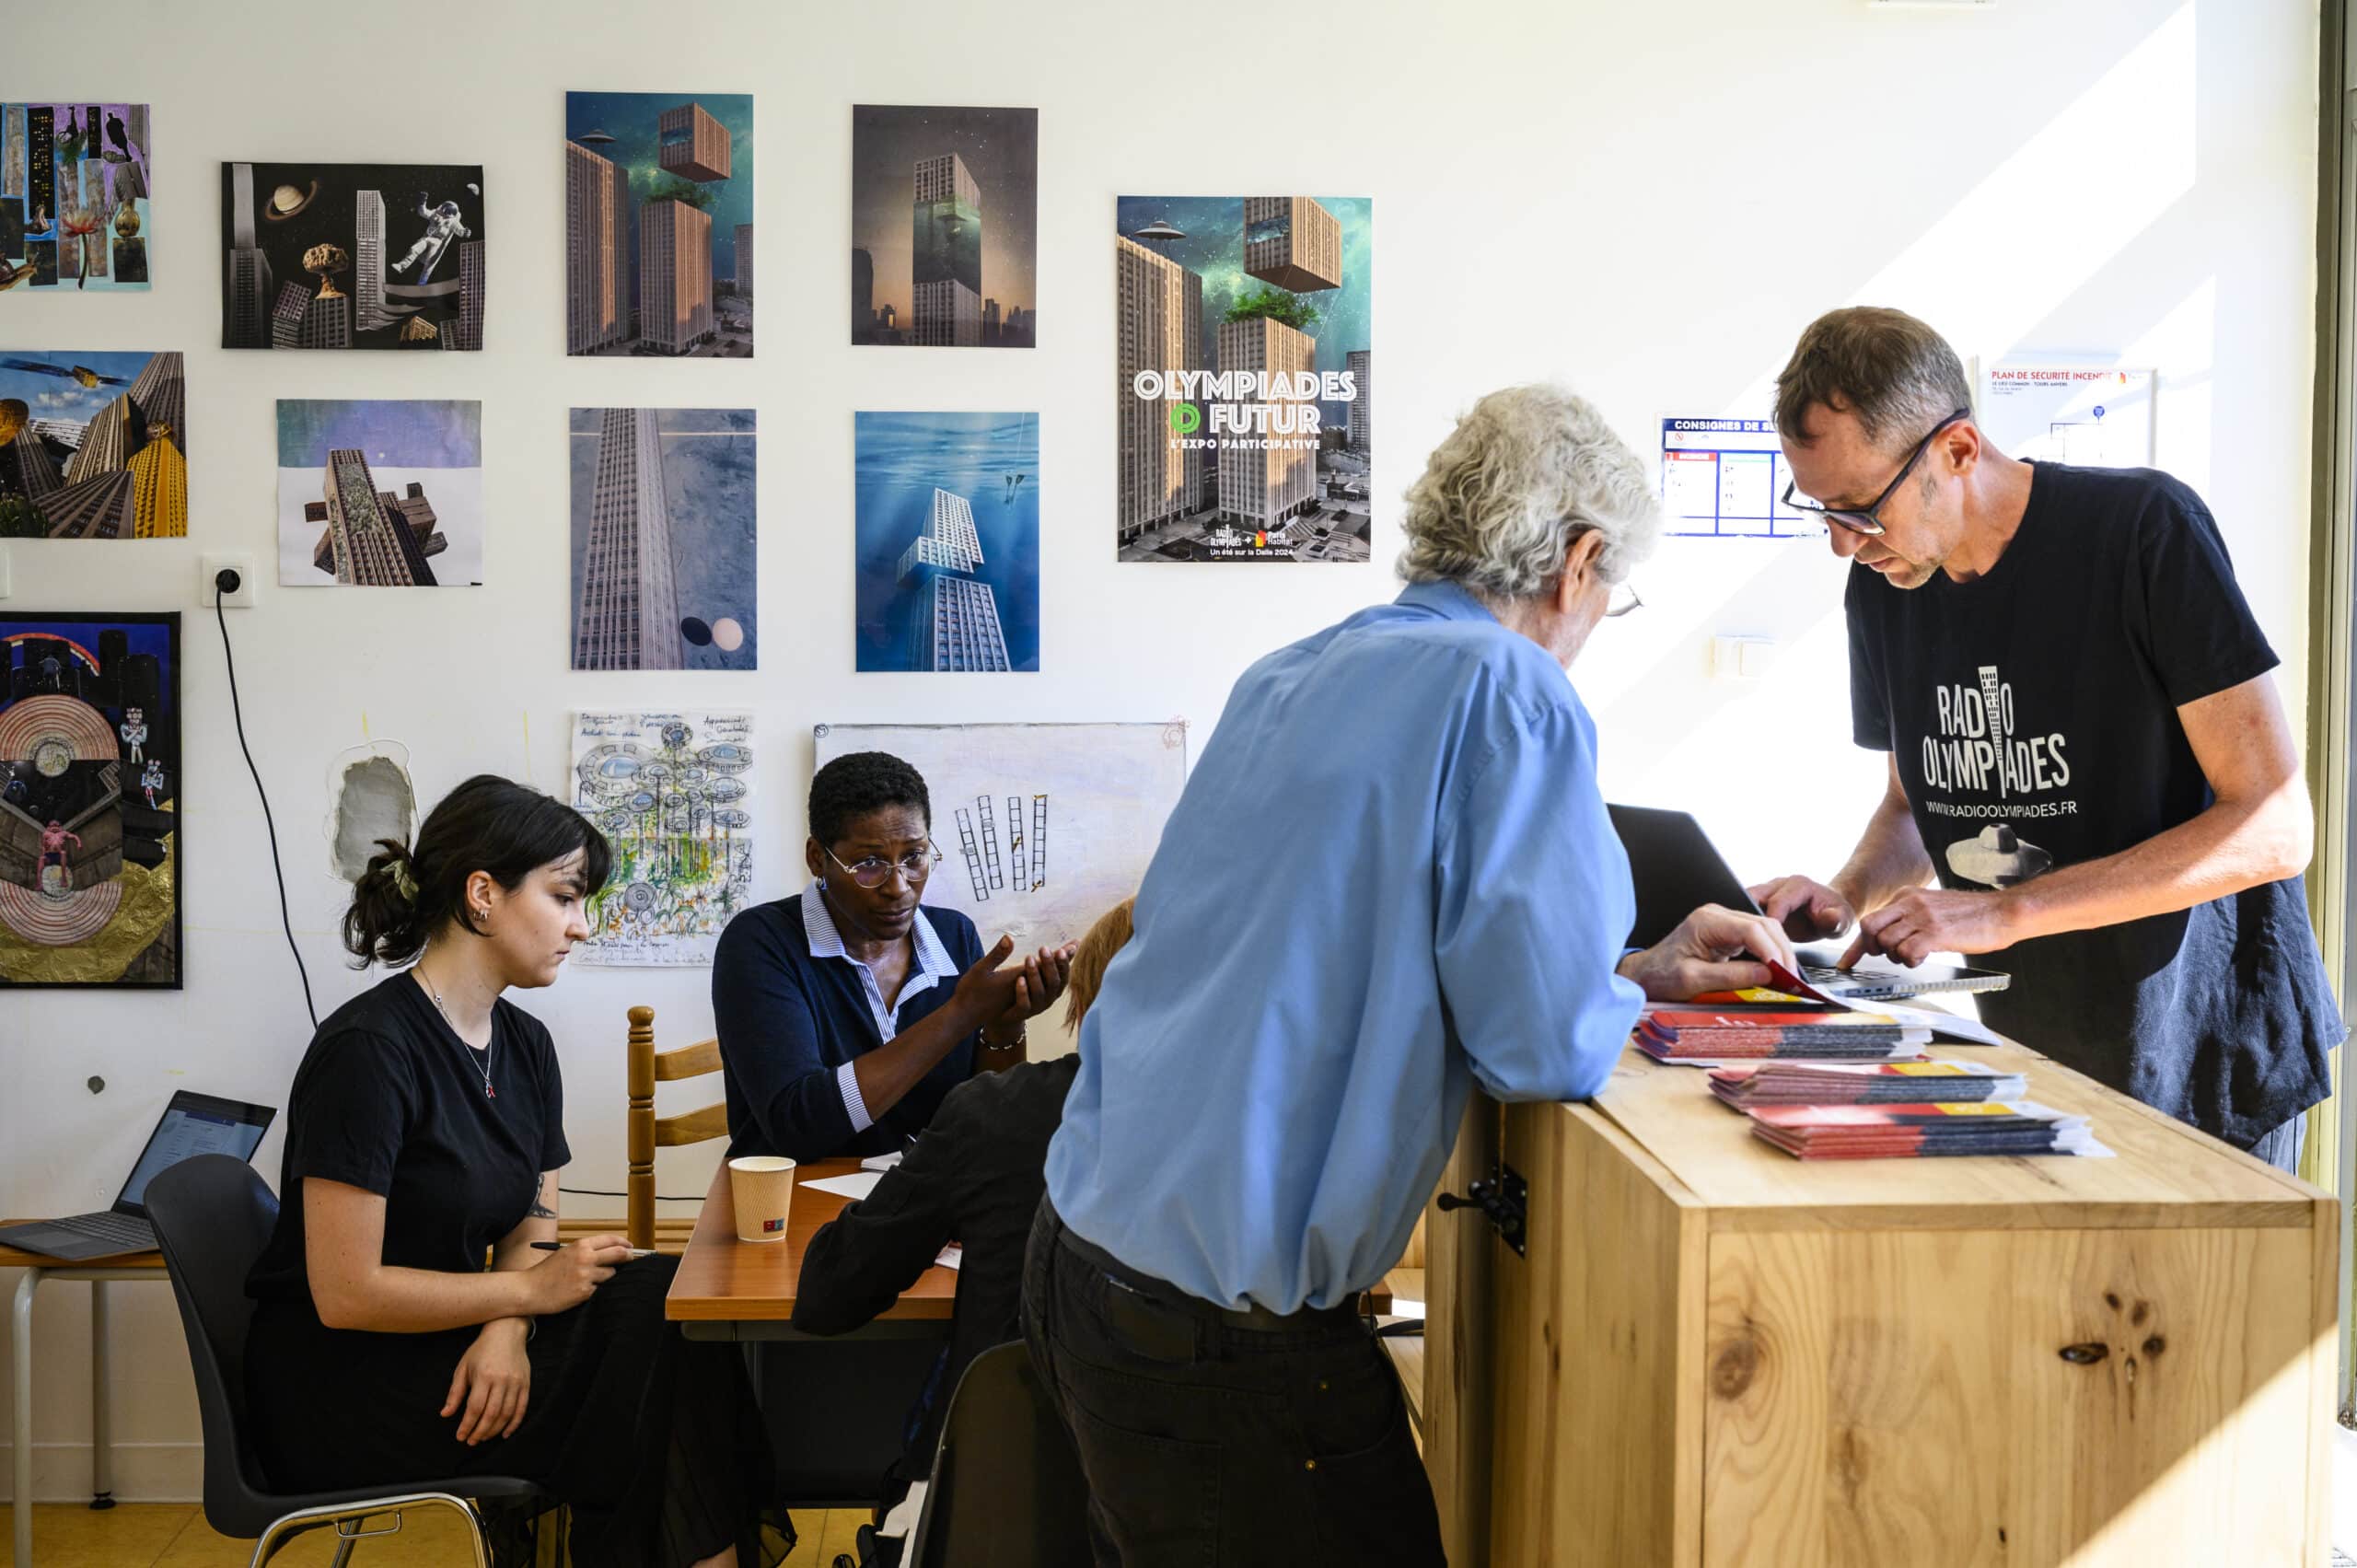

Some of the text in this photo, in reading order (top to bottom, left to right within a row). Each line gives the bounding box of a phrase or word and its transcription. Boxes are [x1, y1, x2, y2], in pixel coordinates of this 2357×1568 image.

[1133, 369, 1357, 401] OLYMPIADES
[1991, 370, 2014, 379] PLAN
[2016, 371, 2027, 379] DE
[1209, 403, 1321, 435] FUTUR
[1675, 420, 1741, 430] CONSIGNES
[1744, 421, 1759, 430] DE
[1170, 438, 1320, 449] L'EXPO PARTICIPATIVE
[1936, 666, 2014, 738] RADIO
[1922, 733, 2070, 798] OLYMPIADES
